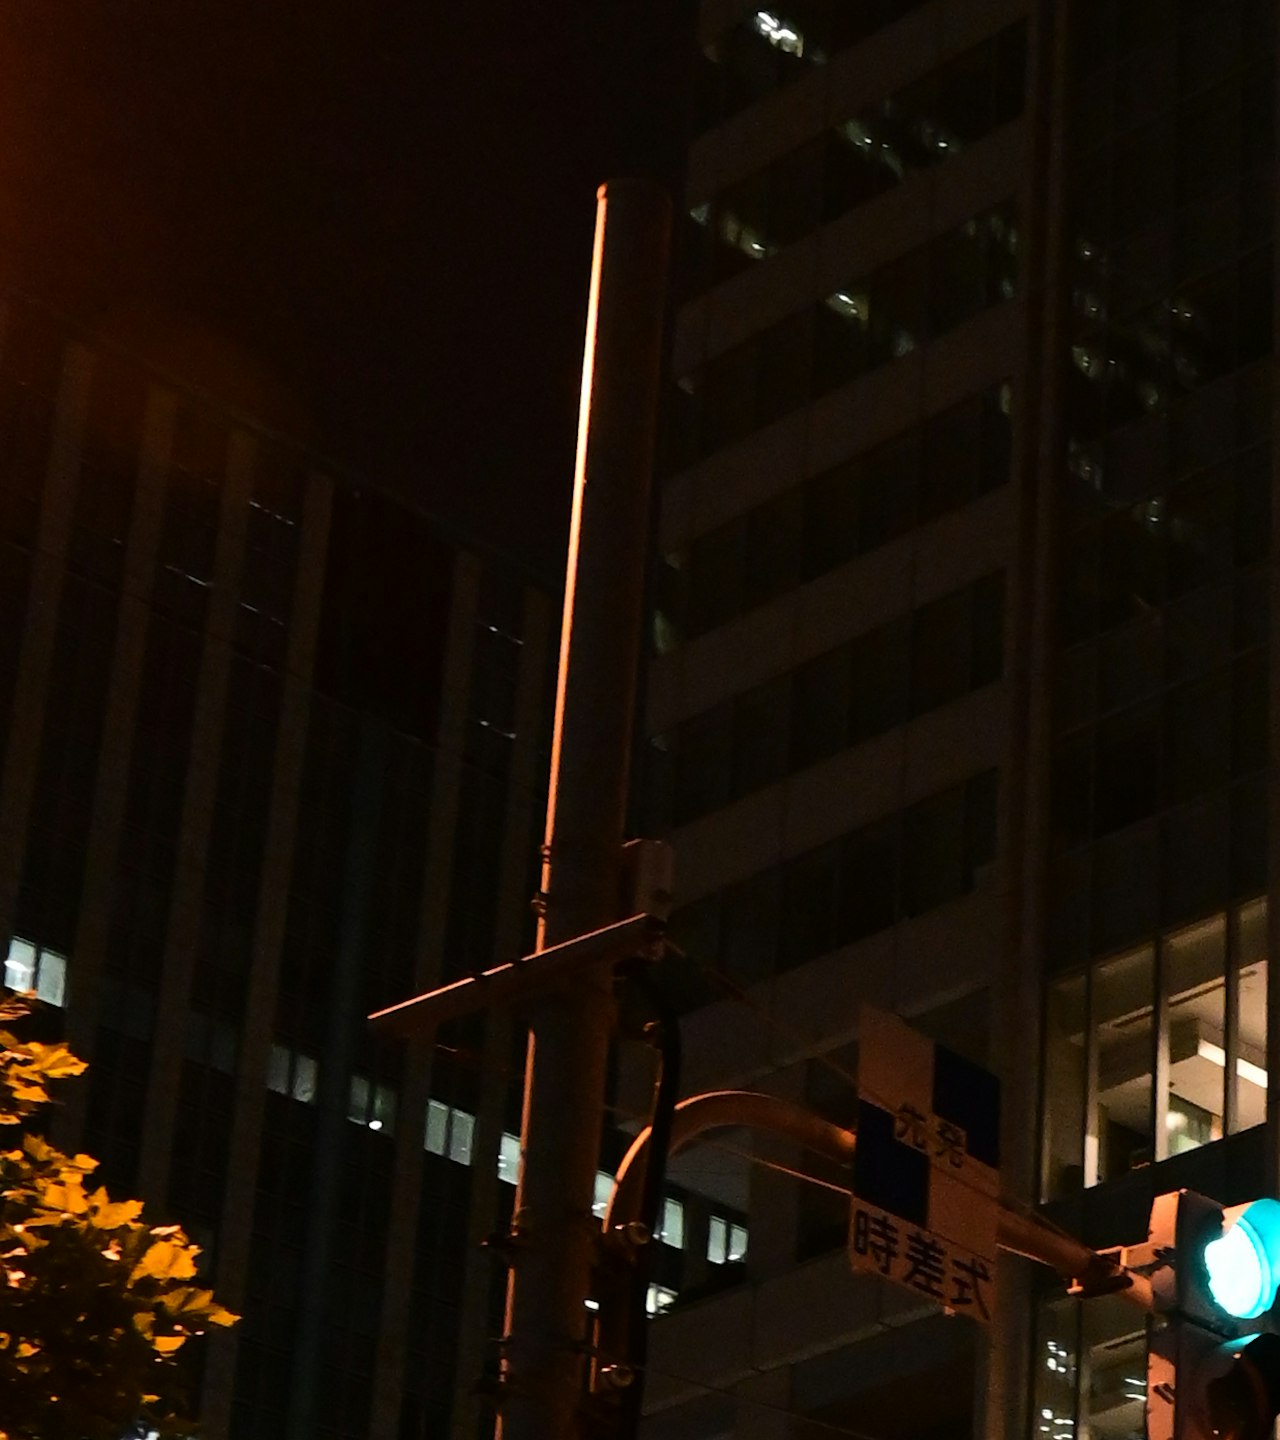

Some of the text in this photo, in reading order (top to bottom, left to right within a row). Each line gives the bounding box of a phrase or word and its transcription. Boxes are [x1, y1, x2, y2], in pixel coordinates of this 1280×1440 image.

[897, 1103, 964, 1169] 先発
[853, 1210, 991, 1321] 時差式
